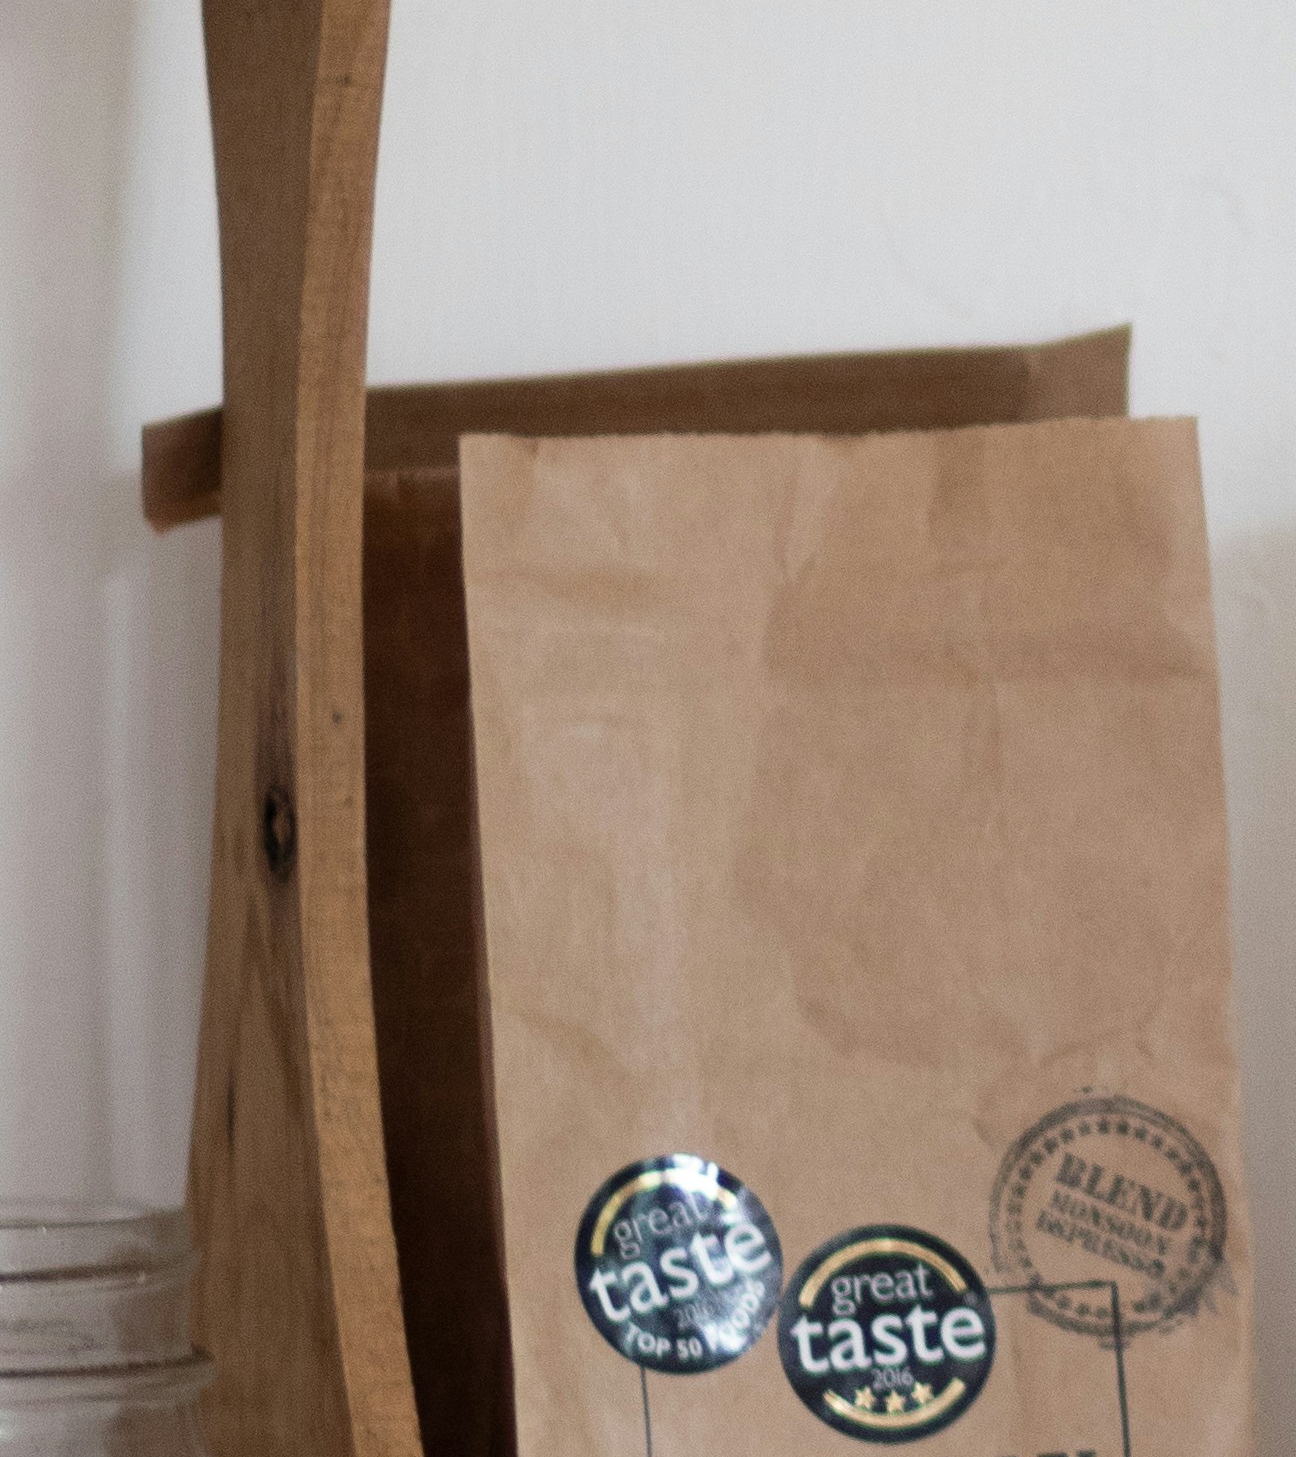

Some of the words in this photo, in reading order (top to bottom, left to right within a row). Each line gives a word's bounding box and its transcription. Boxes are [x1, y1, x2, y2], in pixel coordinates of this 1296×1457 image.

[1056, 1151, 1189, 1232] BLEND
[612, 1192, 710, 1261] great
[588, 1220, 773, 1323] taste
[830, 1261, 934, 1317] great
[624, 1322, 671, 1359] TOP
[675, 1336, 703, 1365] 50
[789, 1303, 987, 1375] taste
[870, 1364, 916, 1390] 2016
